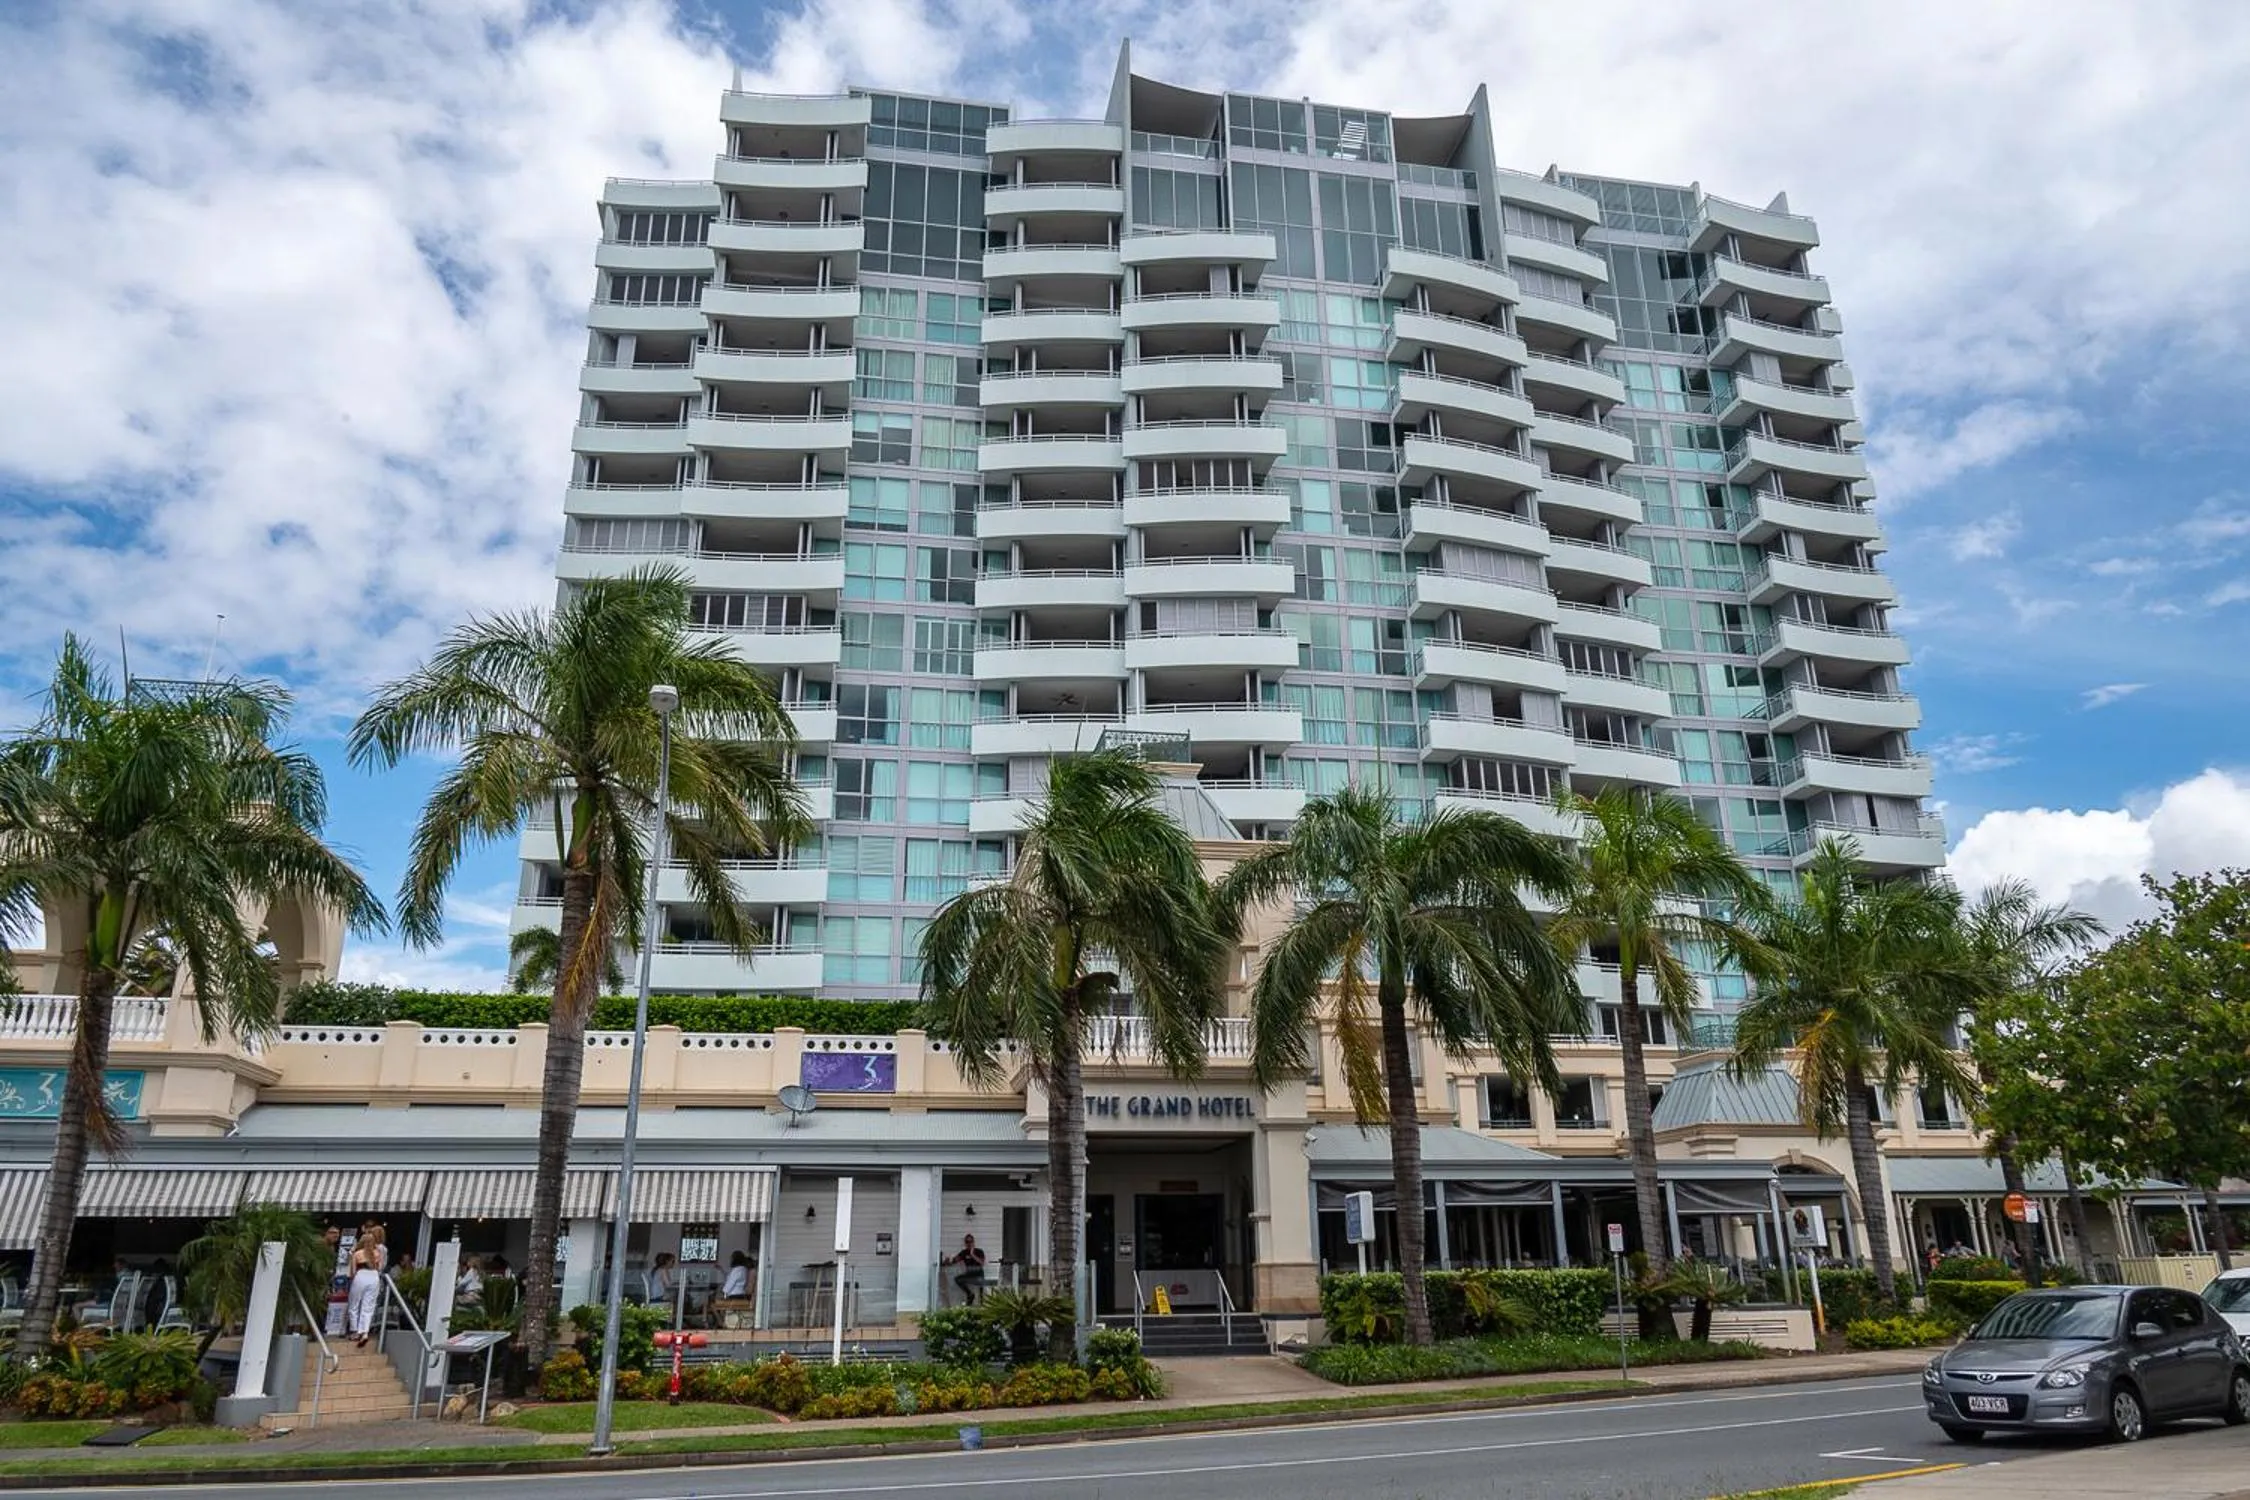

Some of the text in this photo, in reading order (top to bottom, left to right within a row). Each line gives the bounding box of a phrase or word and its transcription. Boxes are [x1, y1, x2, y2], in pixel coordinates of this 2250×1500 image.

[1085, 1096, 1256, 1117] THE GRAND HOTEL
